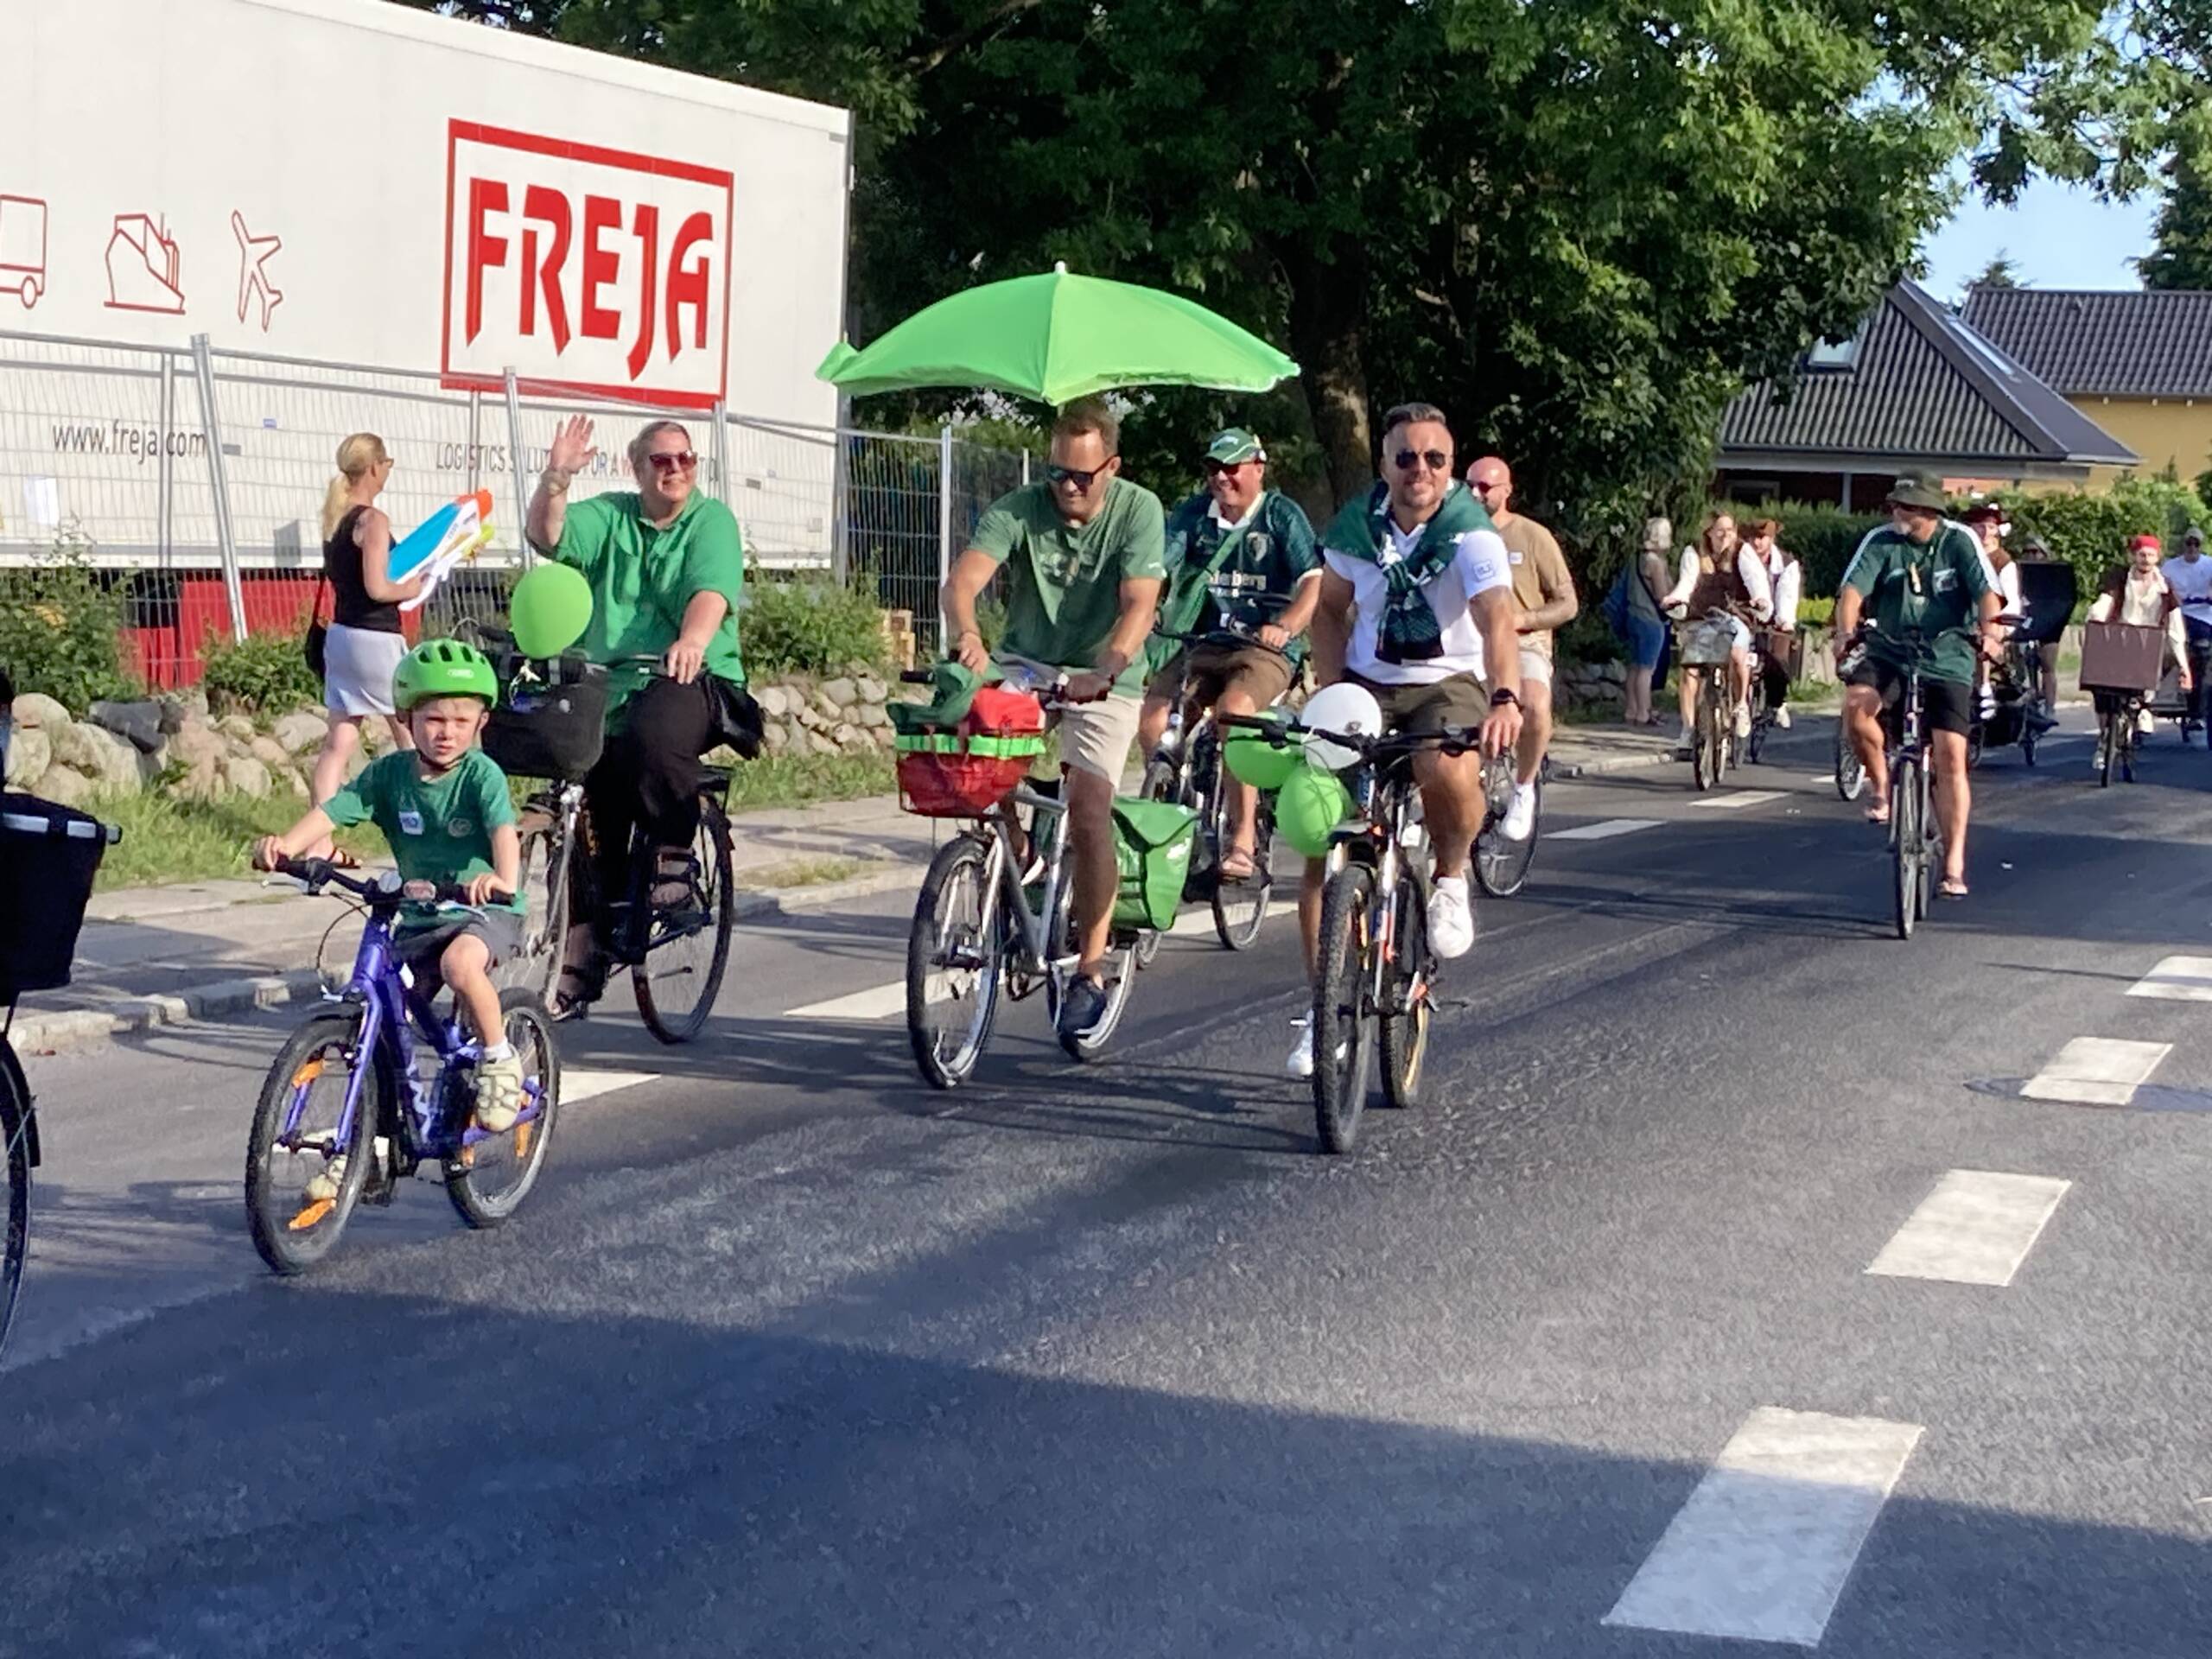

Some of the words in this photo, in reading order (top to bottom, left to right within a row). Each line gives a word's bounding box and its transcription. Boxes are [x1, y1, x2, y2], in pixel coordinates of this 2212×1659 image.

[466, 177, 714, 381] FREJA
[52, 418, 207, 465] www.freja.com
[436, 443, 505, 472] LOGISTICS
